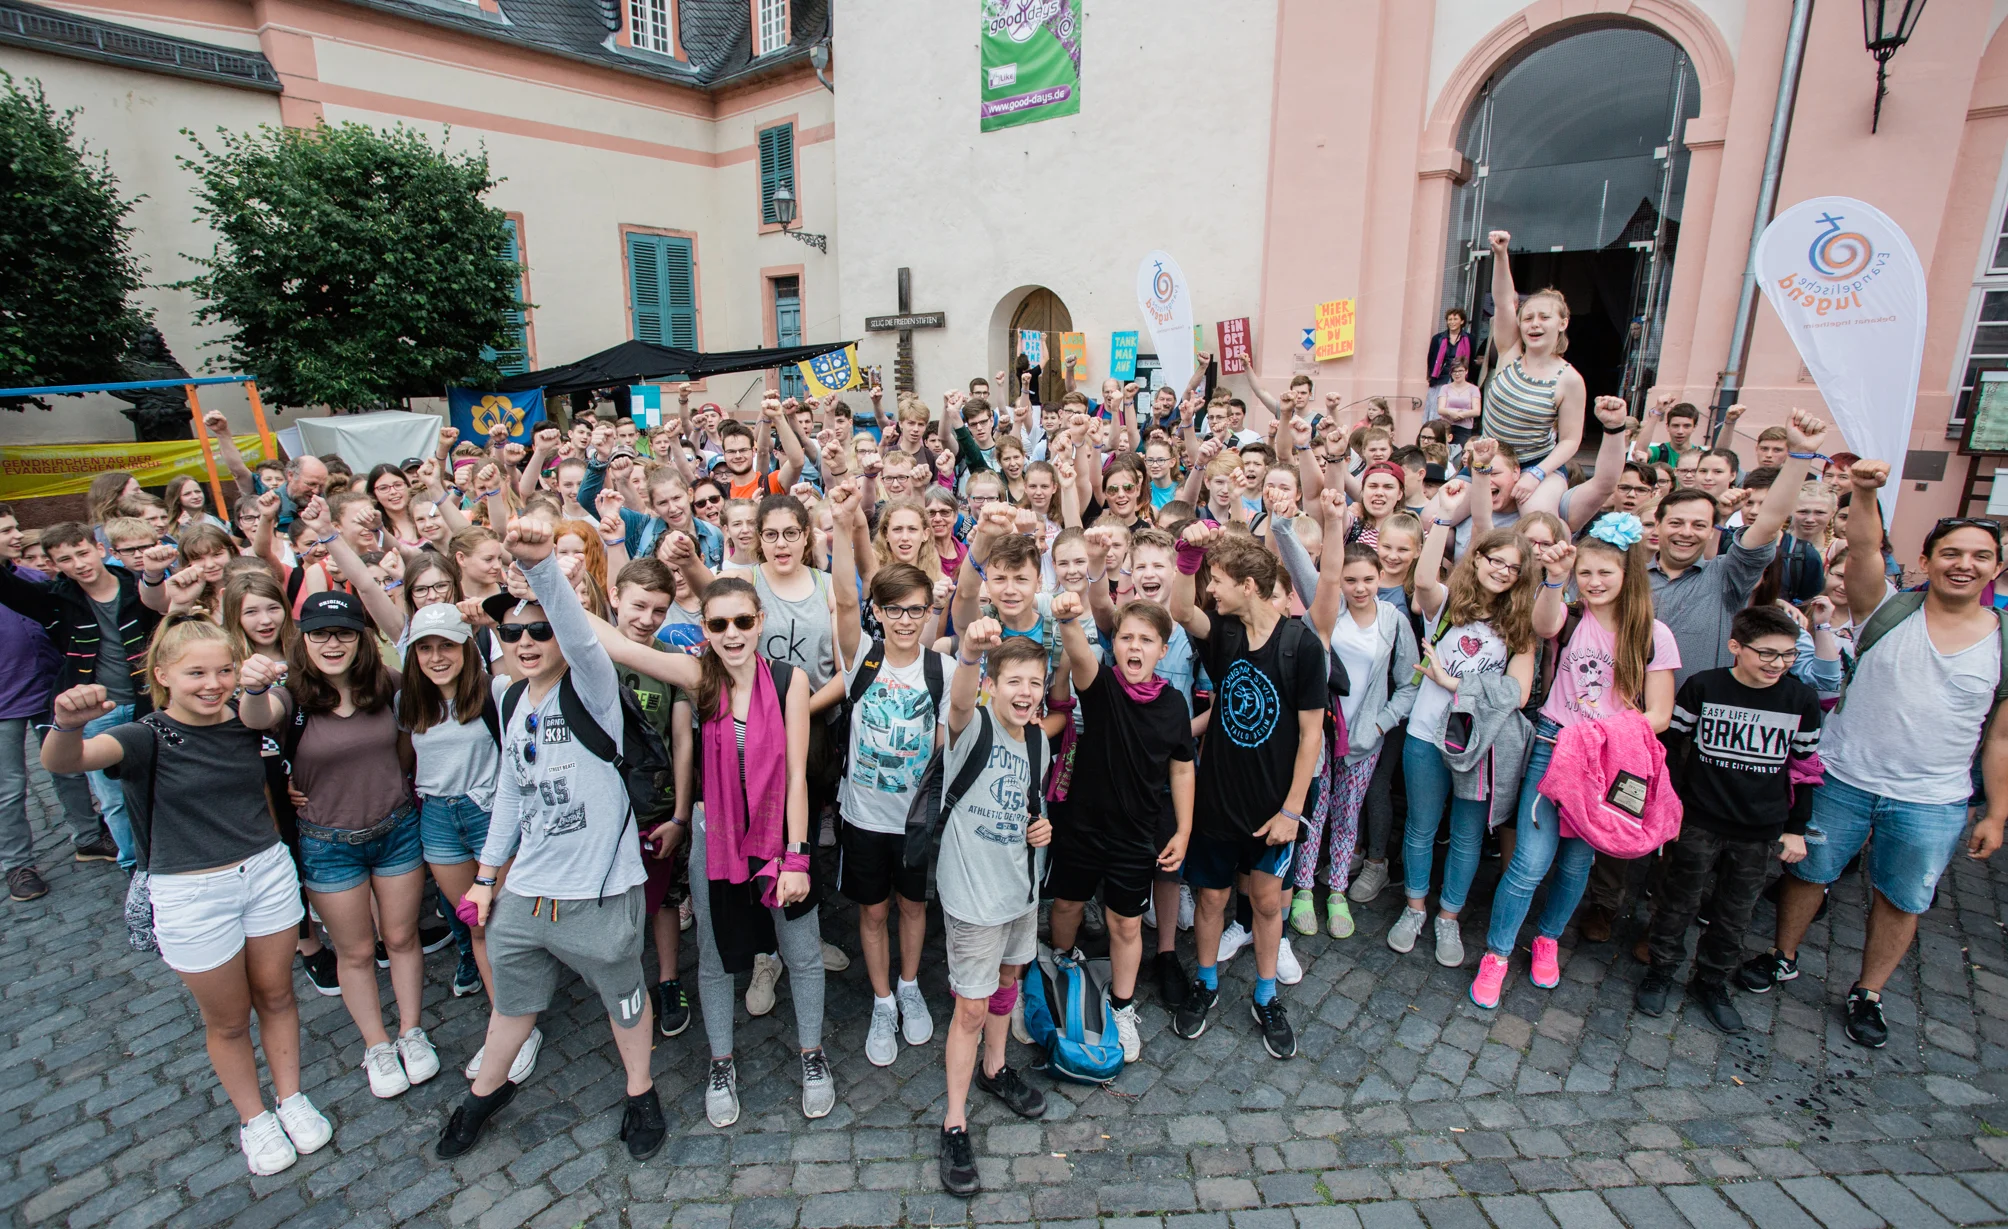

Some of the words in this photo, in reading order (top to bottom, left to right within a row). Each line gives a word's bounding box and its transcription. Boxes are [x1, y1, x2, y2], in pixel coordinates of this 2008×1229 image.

[990, 12, 1022, 35] good
[1027, 2, 1059, 20] days
[988, 89, 1065, 113] www.good-days.de
[894, 318, 915, 326] FRIEDEN
[916, 317, 938, 325] STIFTEN
[1315, 312, 1354, 331] KANNST
[1115, 336, 1137, 347] TANK
[1223, 332, 1244, 346] ORT
[1327, 328, 1341, 341] DU
[1115, 348, 1133, 360] MAL
[1225, 344, 1247, 359] DER
[1115, 361, 1131, 372] AUF
[128, 455, 152, 464] DER
[4, 464, 115, 476] EVANGELISCHEN
[767, 618, 807, 662] ck
[1702, 706, 1725, 718] EASY
[1729, 710, 1748, 721] LIFE
[1701, 717, 1795, 755] BRKLYN
[1715, 759, 1730, 768] THE
[967, 805, 1002, 820] ATHLETIC
[619, 987, 642, 1020] 10
